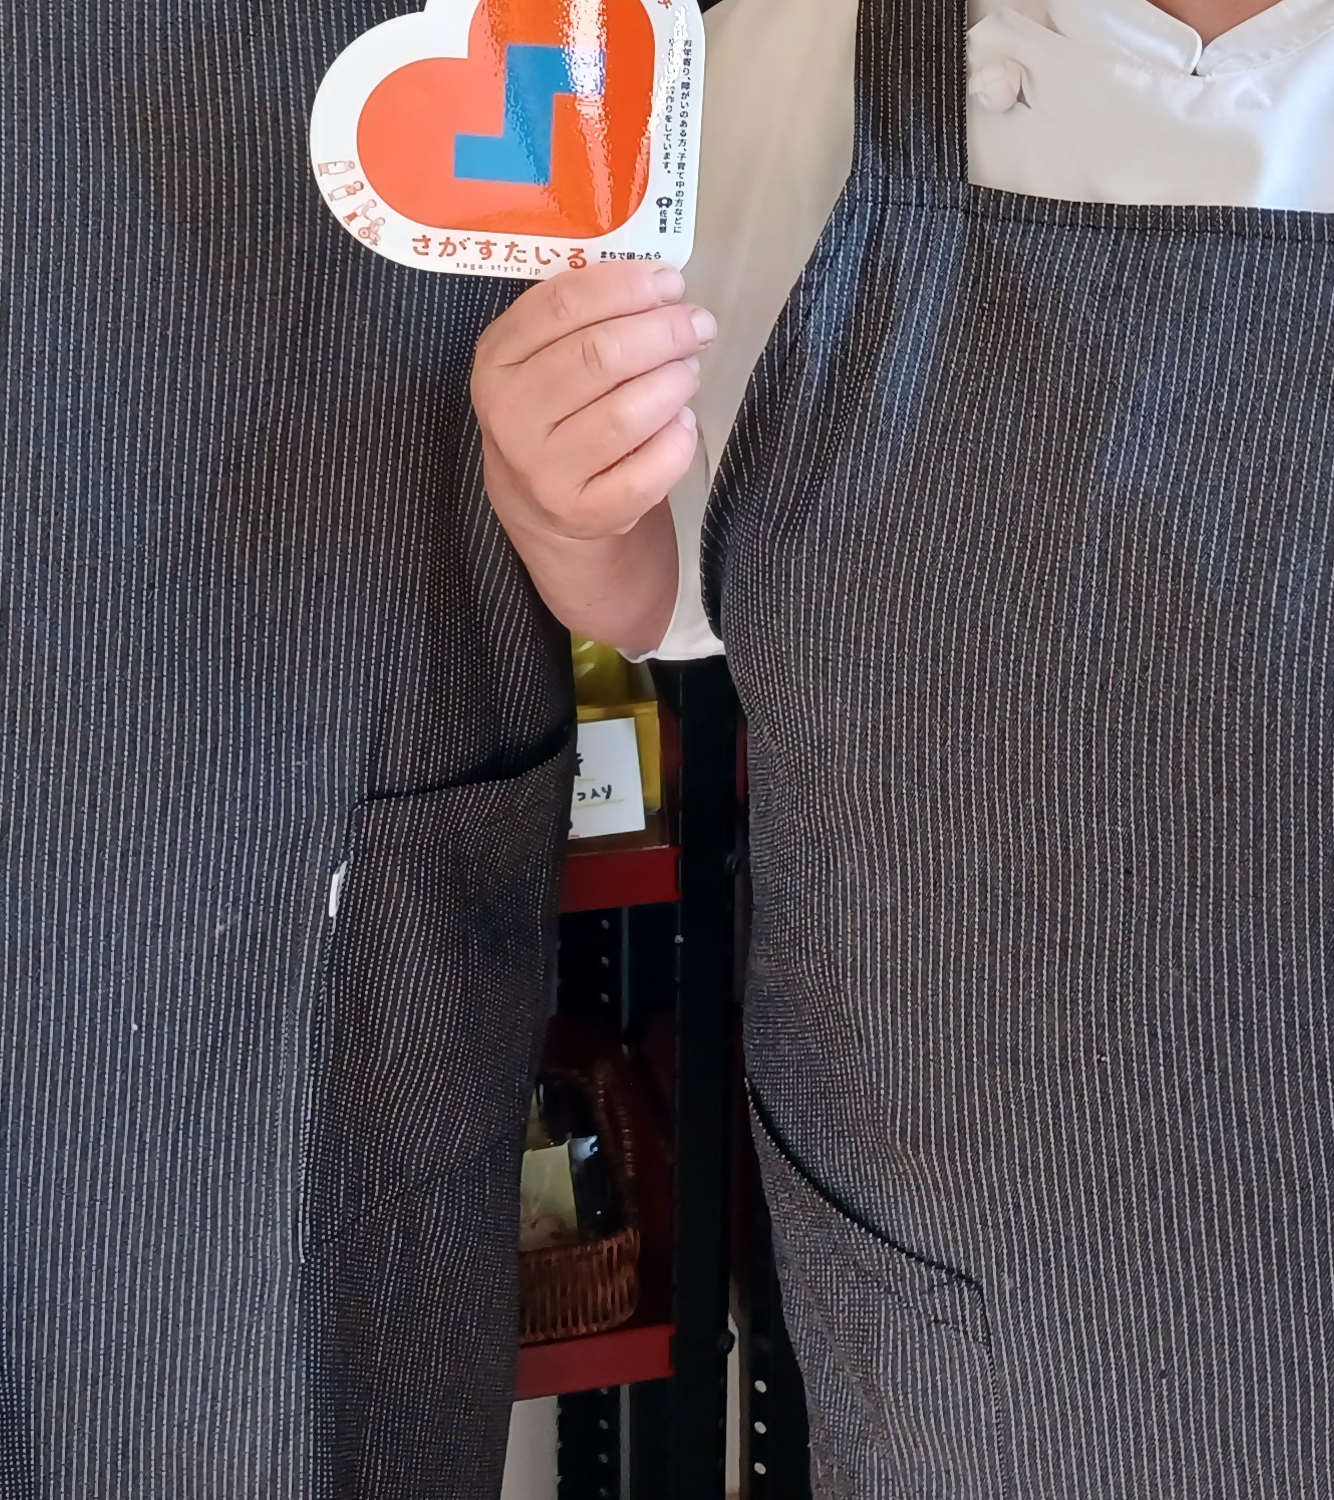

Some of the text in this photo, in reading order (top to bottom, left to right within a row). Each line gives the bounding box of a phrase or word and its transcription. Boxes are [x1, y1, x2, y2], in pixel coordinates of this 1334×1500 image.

[412, 234, 588, 270] さがすたいる
[599, 250, 662, 261] まちで困ったら
